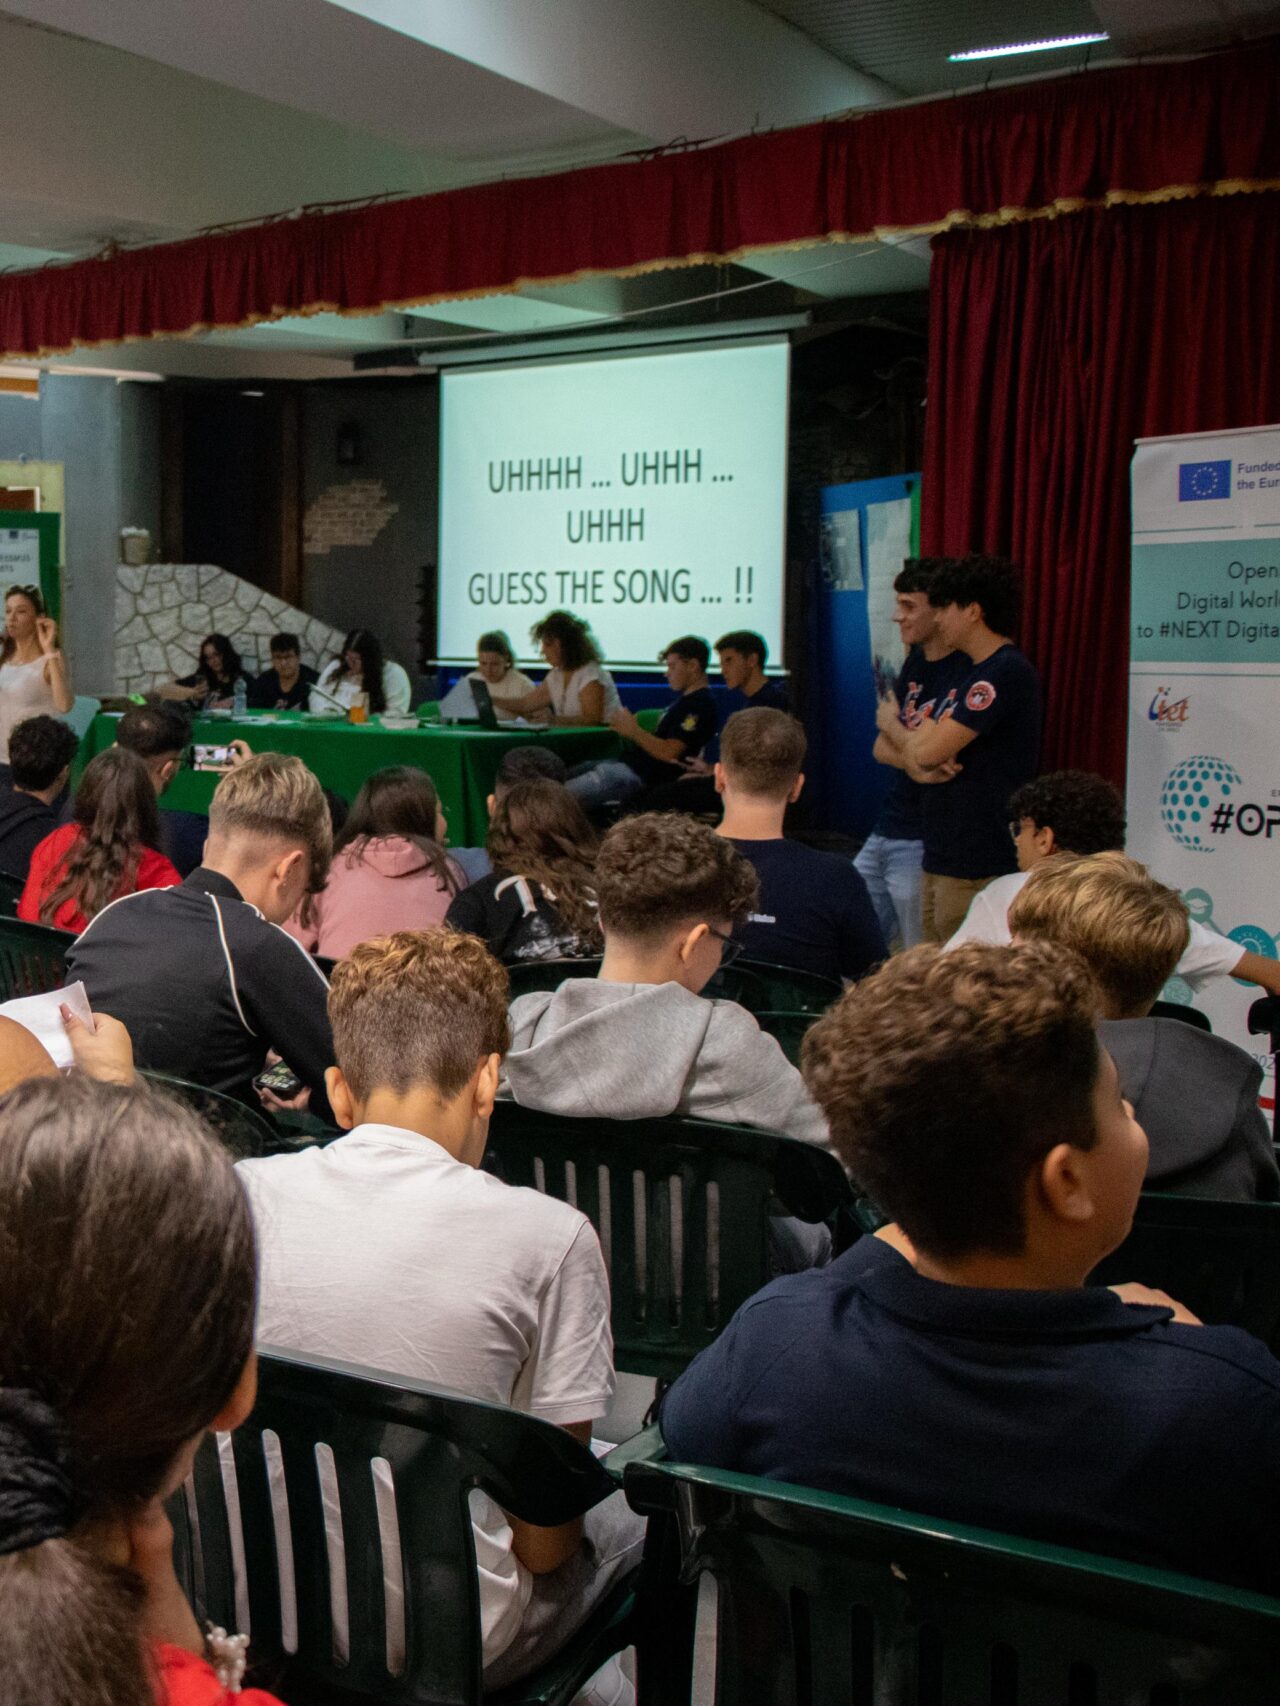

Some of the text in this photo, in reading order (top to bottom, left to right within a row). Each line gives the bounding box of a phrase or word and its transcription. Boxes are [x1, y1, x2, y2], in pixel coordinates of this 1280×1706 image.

[488, 456, 582, 493] UHHHH
[621, 448, 702, 486] UHHH
[1237, 479, 1256, 490] the
[566, 507, 645, 543] UHHH
[1228, 560, 1279, 585] Open
[468, 570, 548, 606] GUESS
[556, 569, 604, 604] THE
[612, 568, 690, 604] SONG
[1177, 589, 1280, 614] Digital Worl
[1136, 625, 1154, 638] to
[1160, 620, 1221, 638] #NEXT
